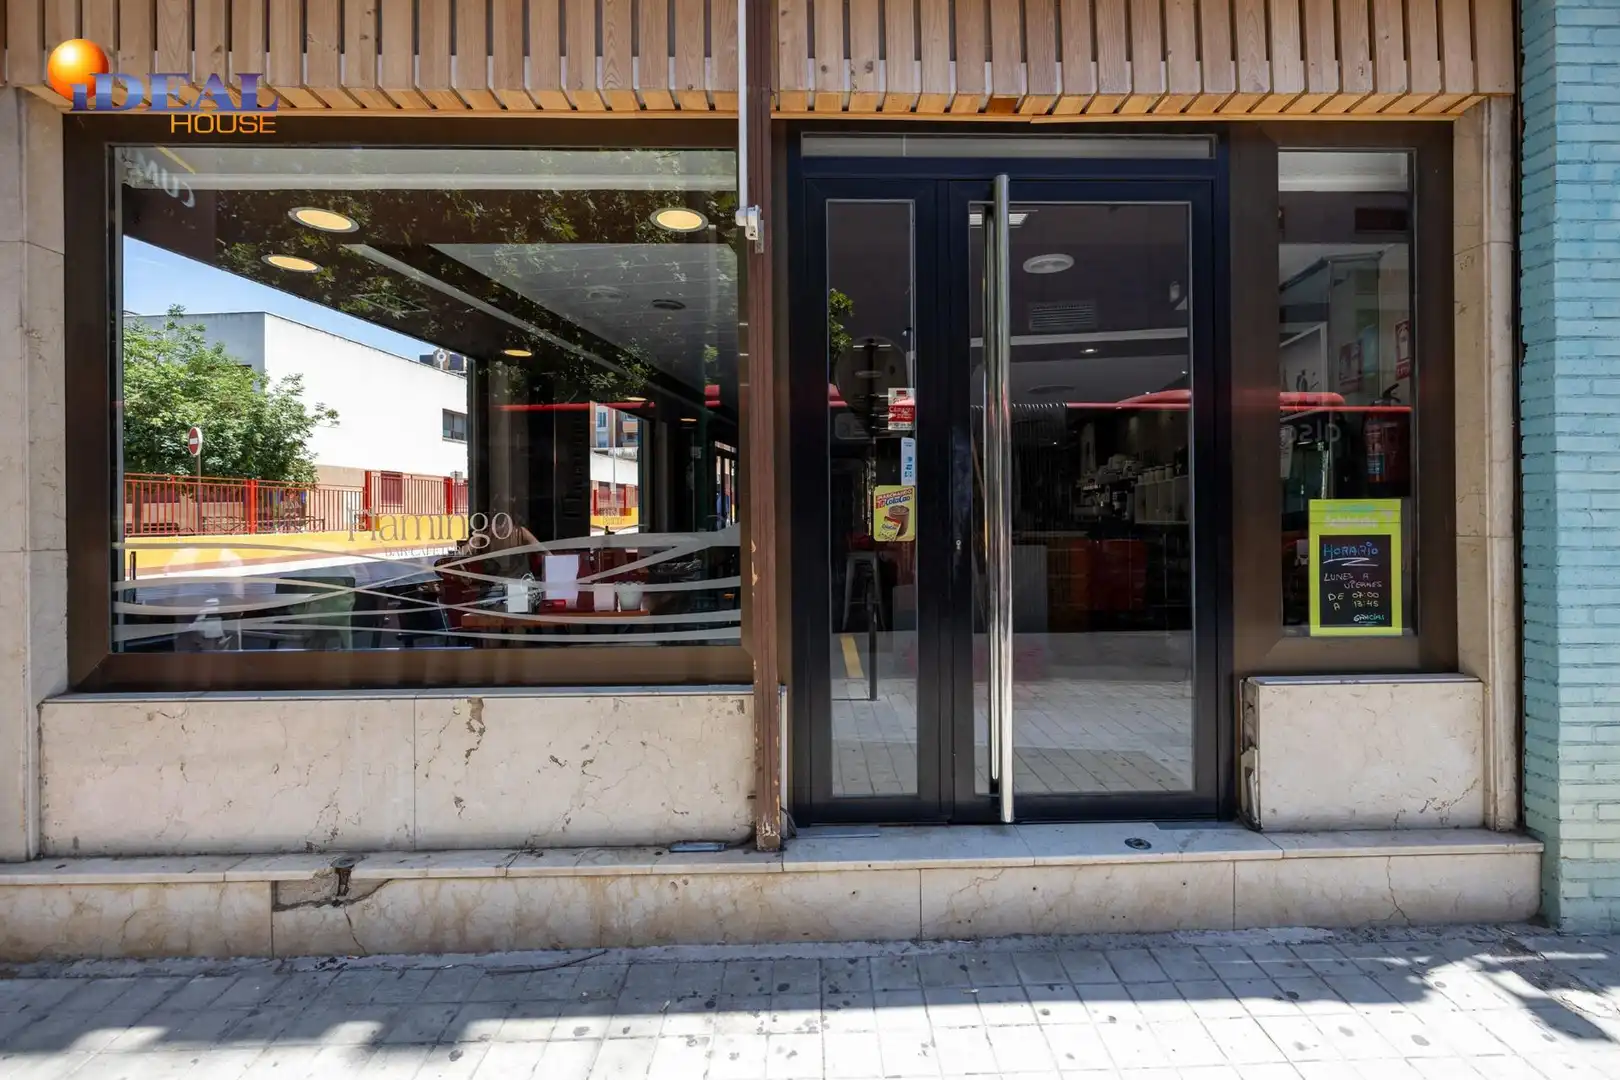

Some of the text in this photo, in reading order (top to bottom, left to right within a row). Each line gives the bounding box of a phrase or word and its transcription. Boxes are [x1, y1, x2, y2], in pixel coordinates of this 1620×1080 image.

[347, 506, 513, 549] Flamingo
[1323, 572, 1354, 582] LUNES
[1327, 592, 1345, 602] DE
[1333, 602, 1341, 611] A
